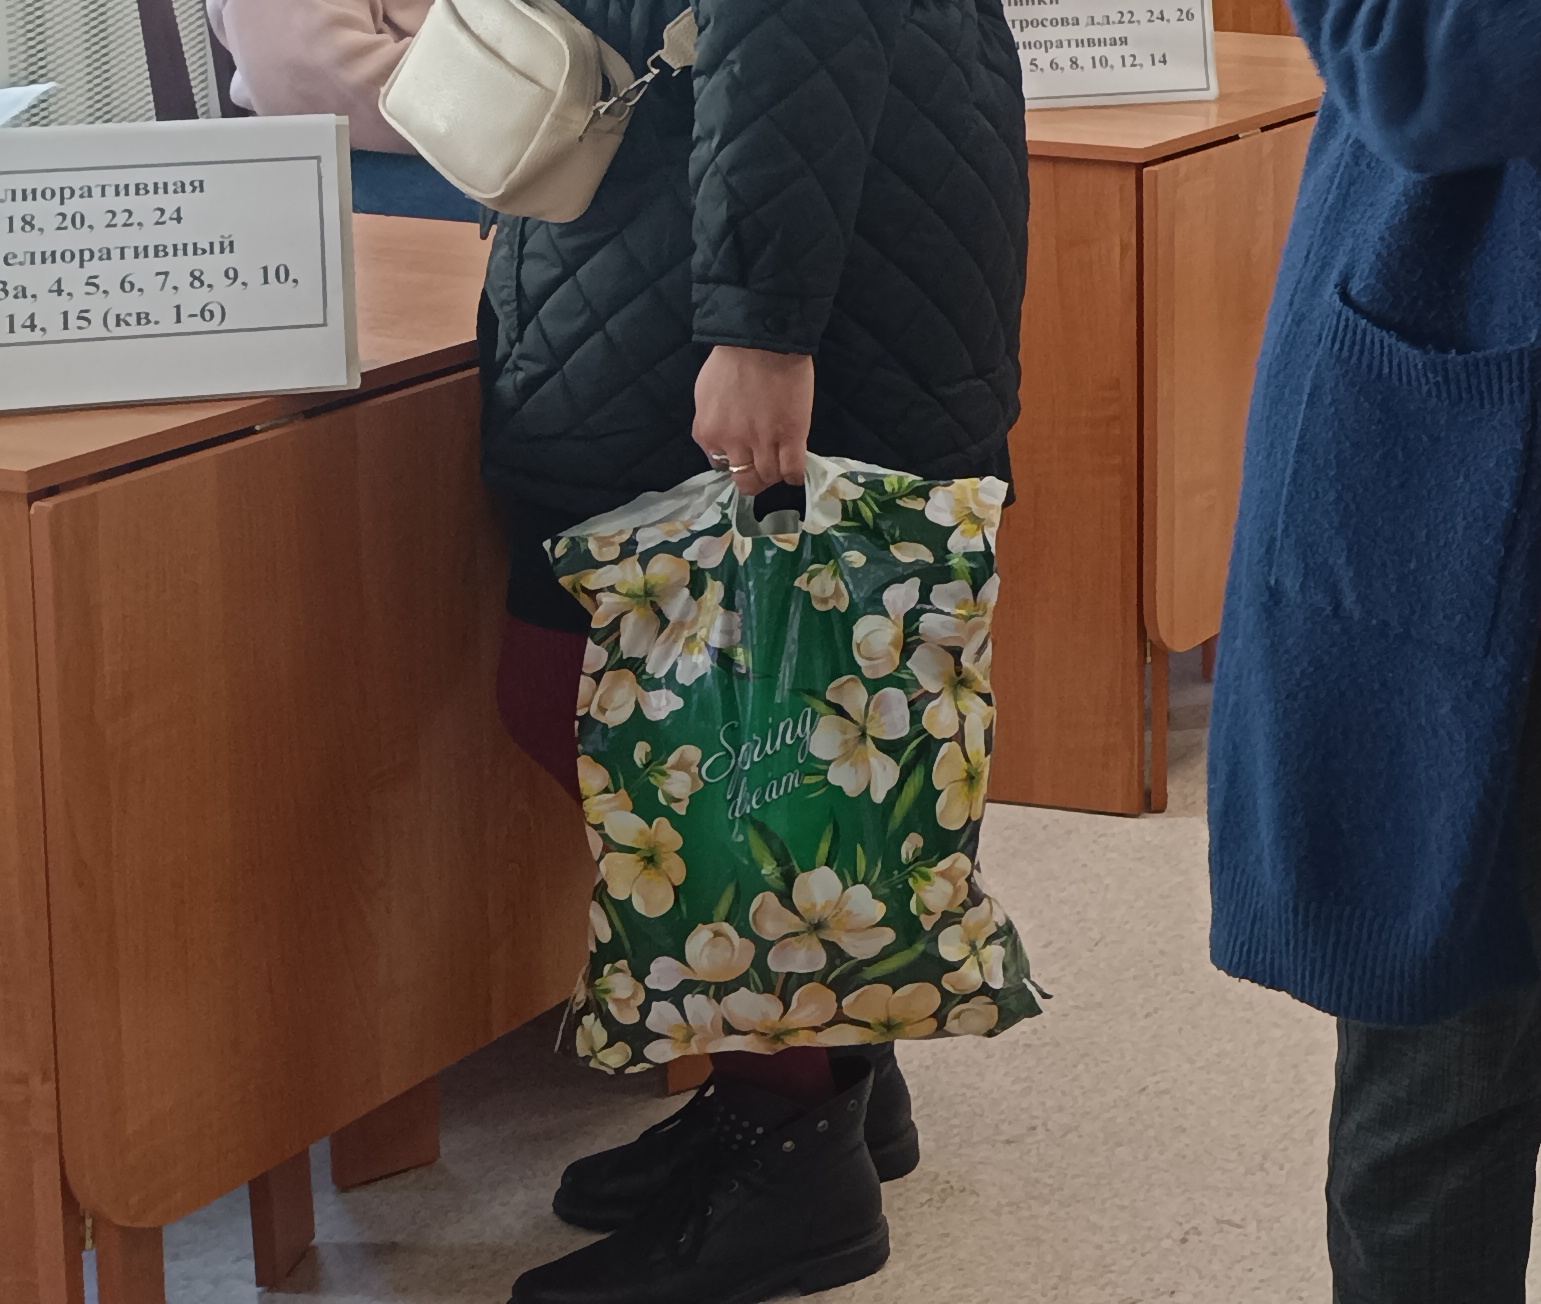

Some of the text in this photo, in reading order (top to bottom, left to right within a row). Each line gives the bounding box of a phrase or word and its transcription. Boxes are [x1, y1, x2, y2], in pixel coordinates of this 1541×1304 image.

[1146, 8, 1171, 24] 24,
[1176, 7, 1196, 22] 26
[1029, 52, 1169, 74] 5, 6, 8, 10, 12, 14
[5, 206, 184, 236] 18, 20, 22, 24
[3, 234, 236, 269] елиоративный
[47, 276, 74, 301] 4,
[84, 274, 110, 298] 5,
[119, 272, 145, 296] 6,
[154, 270, 180, 295] 7,
[189, 268, 214, 293] 8,
[223, 266, 249, 291] 9,
[259, 263, 300, 288] 10,
[5, 300, 227, 337] 14, 15 (кв. 1-6)
